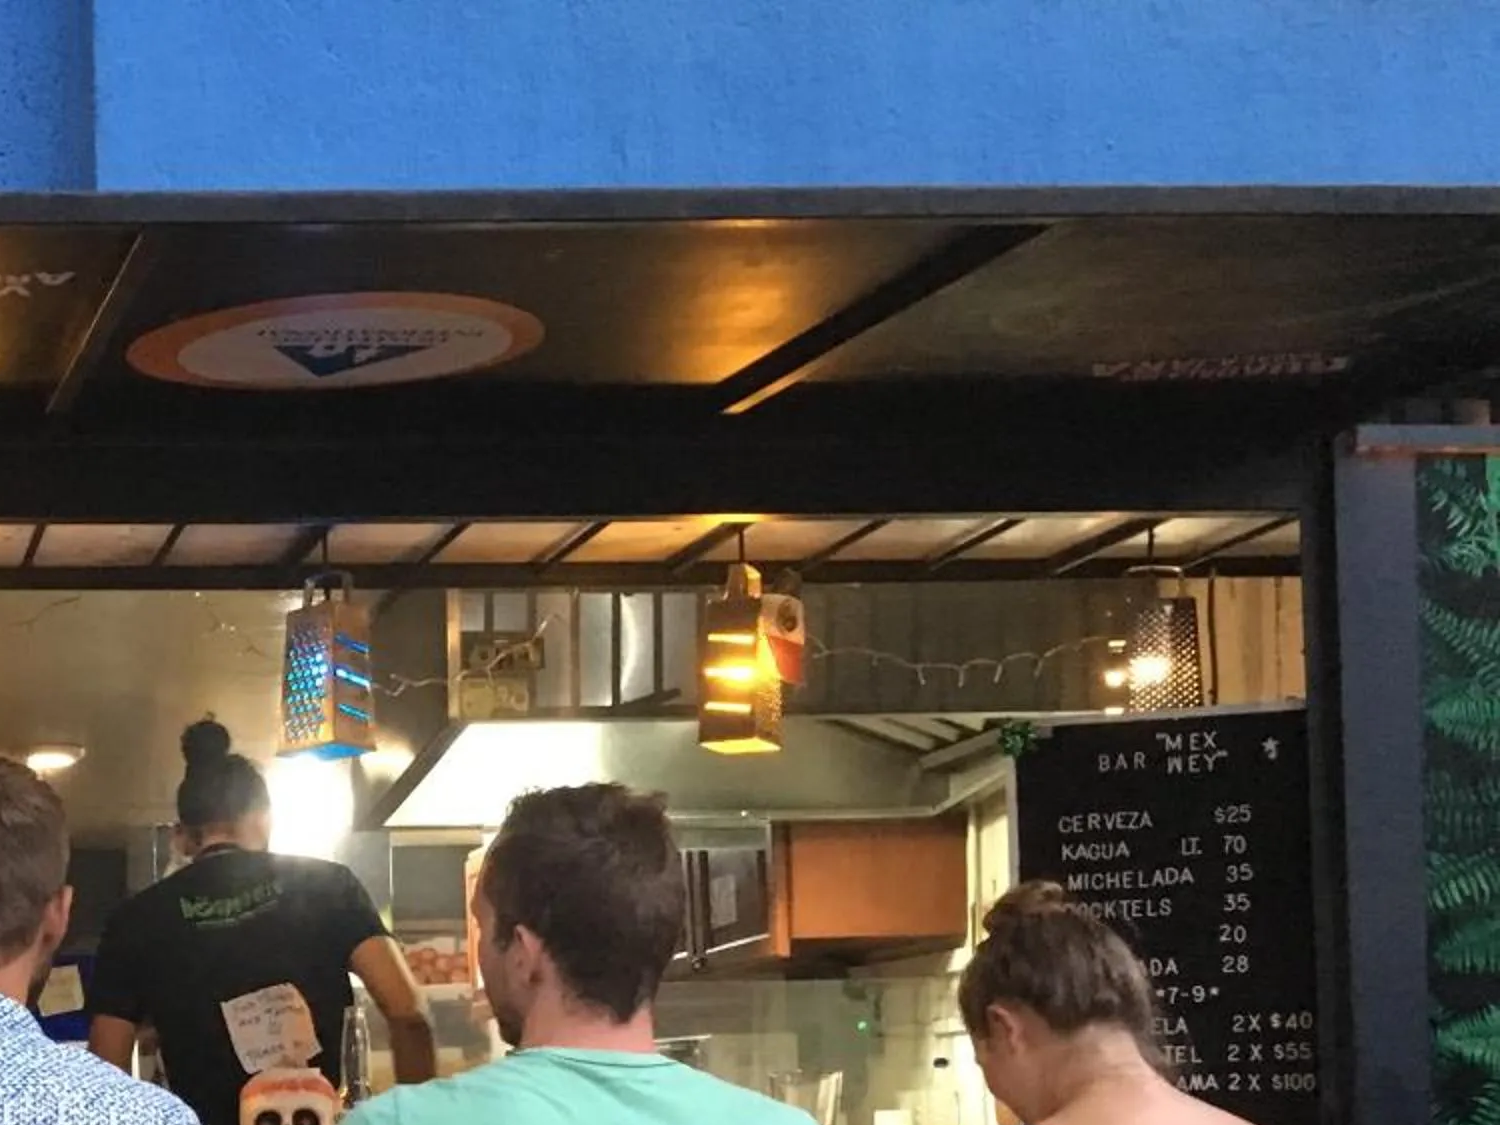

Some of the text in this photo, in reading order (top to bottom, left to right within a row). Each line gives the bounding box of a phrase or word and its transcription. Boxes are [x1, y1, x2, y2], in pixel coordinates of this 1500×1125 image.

[1099, 752, 1146, 772] BAR
[1059, 804, 1252, 833] CERVEZA $25
[1061, 840, 1130, 861] KAGUA
[1223, 835, 1246, 855] 70
[1067, 864, 1253, 892] MICHELADA 35
[1224, 894, 1251, 912] 35
[1219, 924, 1246, 943] 20
[1221, 955, 1250, 973] 28
[1273, 1041, 1313, 1061] $55
[1272, 1073, 1316, 1092] $100
